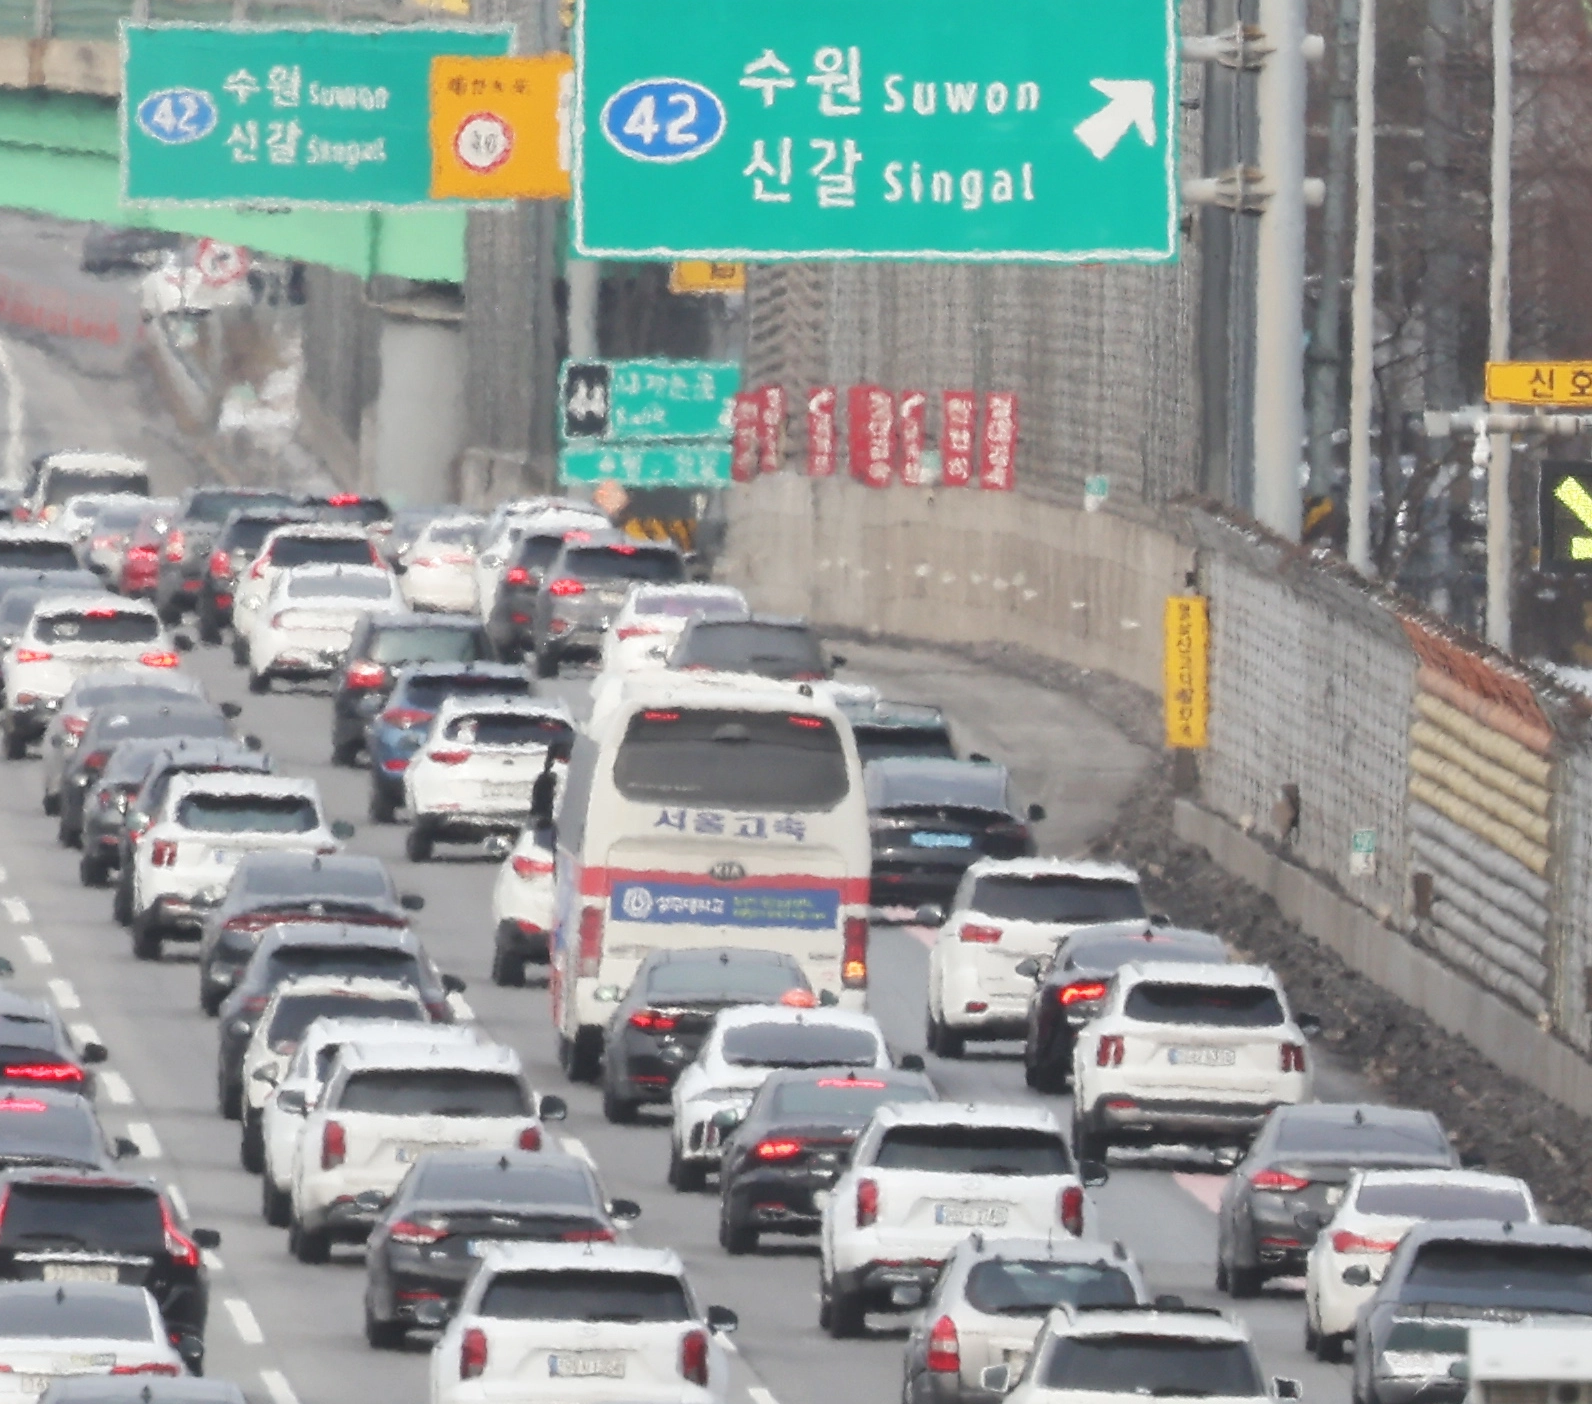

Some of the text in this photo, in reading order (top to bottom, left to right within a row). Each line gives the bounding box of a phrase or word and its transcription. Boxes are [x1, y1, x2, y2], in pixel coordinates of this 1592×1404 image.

[222, 65, 391, 112] 수원 Suwon
[738, 45, 1041, 117] 수원 Suwon
[151, 96, 200, 134] 42
[622, 94, 699, 145] 42
[224, 119, 303, 165] 신갈
[742, 136, 1035, 211] 신갈 Singal
